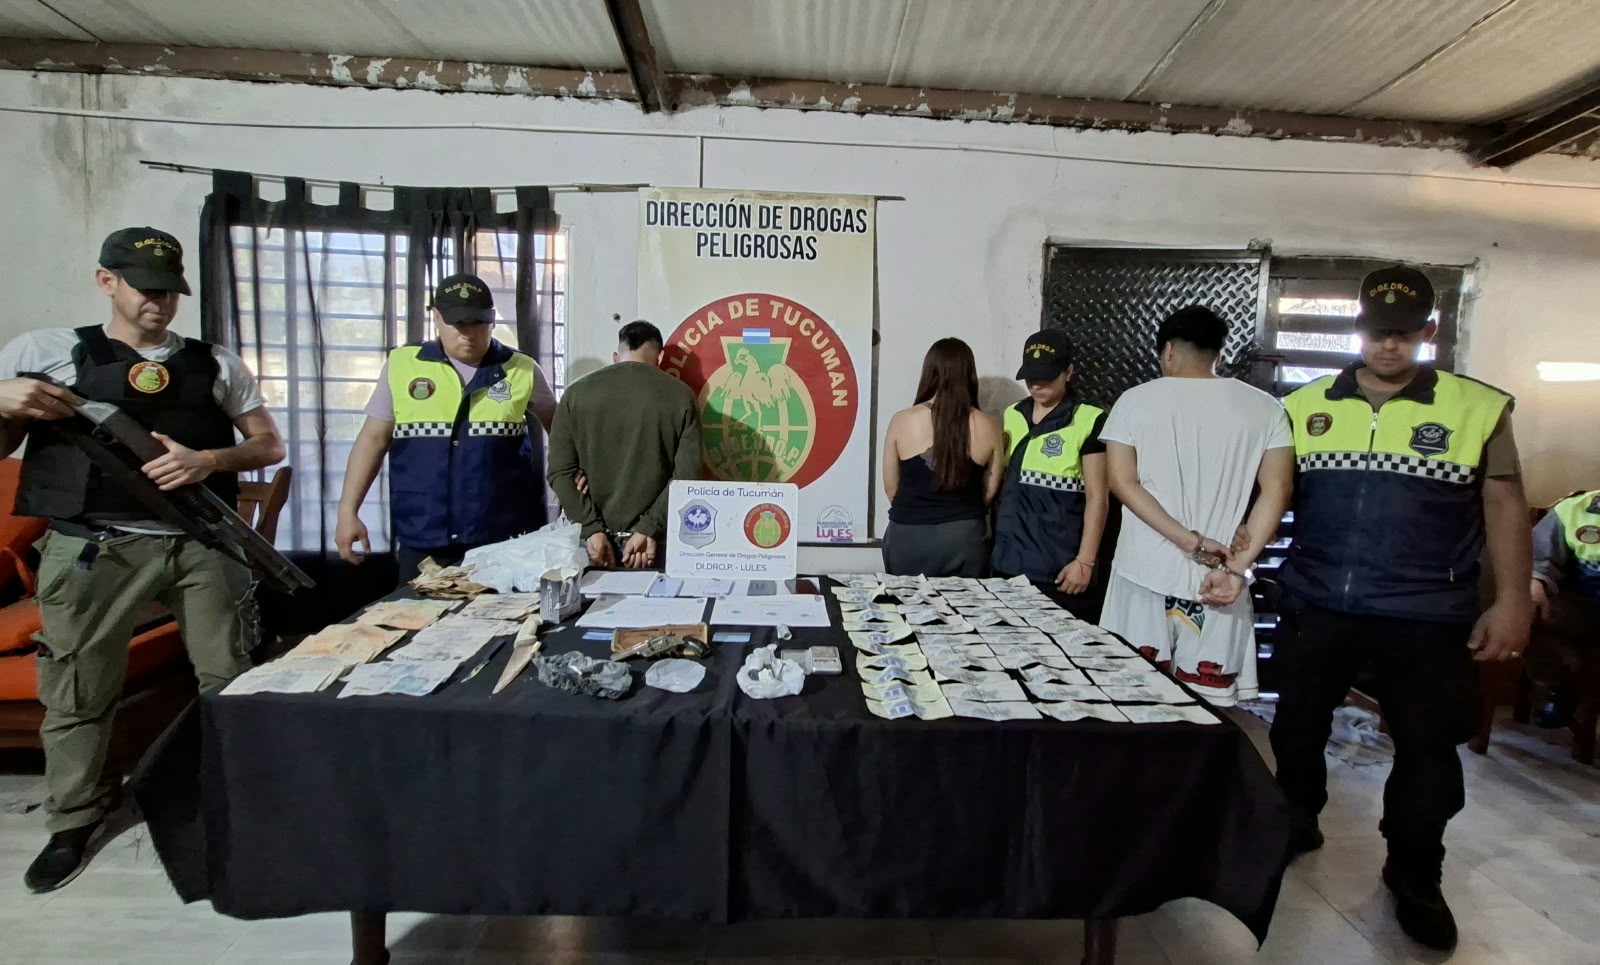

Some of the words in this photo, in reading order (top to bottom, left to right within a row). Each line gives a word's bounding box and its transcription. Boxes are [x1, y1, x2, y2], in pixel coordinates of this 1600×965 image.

[646, 198, 751, 229] DIRECCIÓN
[759, 205, 783, 230] DE
[790, 206, 867, 234] DROGAS
[696, 232, 818, 261] PELIGROSAS
[727, 298, 760, 320] DE
[769, 299, 848, 407] TUCUMAN
[722, 487, 735, 497] de
[737, 487, 784, 499] Tucumán
[816, 525, 854, 539] LULES
[740, 564, 767, 572] LULES
